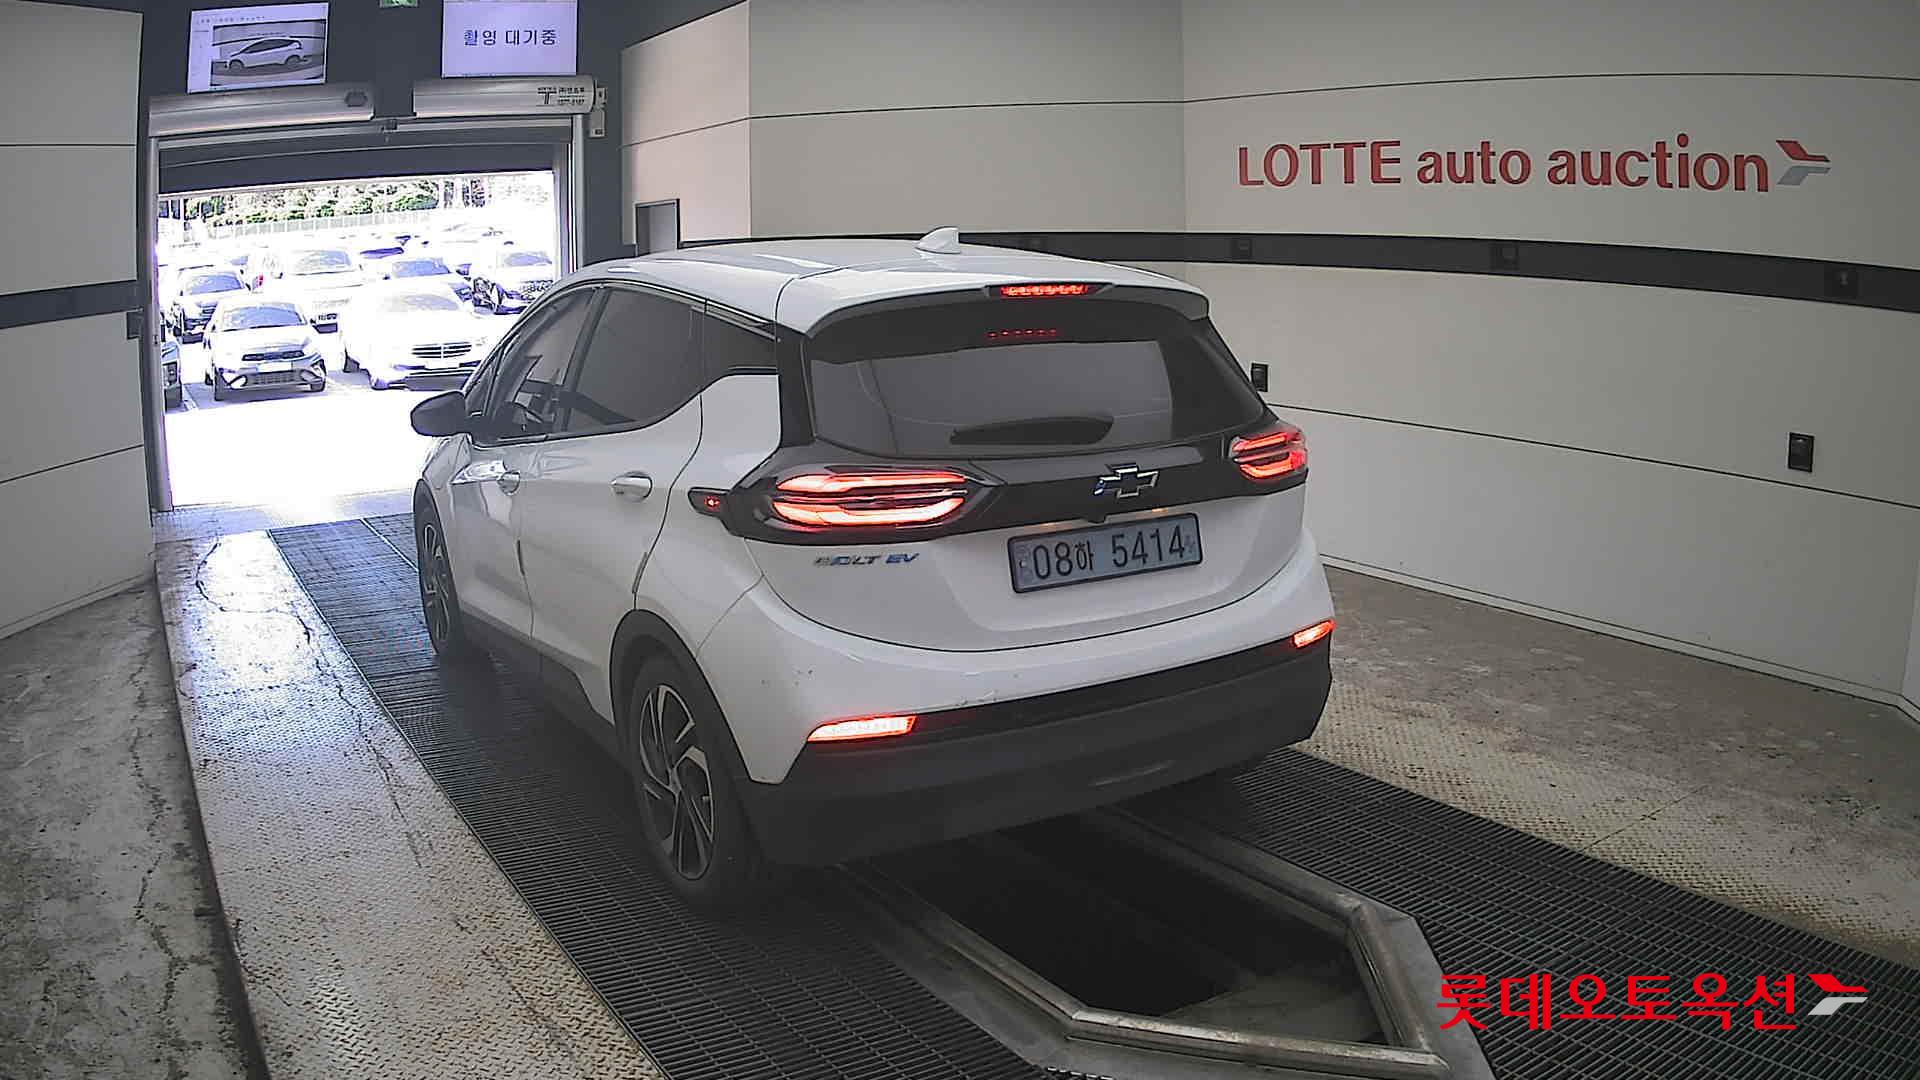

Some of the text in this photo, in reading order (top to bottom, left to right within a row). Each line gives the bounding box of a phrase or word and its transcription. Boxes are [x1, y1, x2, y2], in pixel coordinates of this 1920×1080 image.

[505, 29, 557, 46] 대기중
[1238, 133, 1769, 193] LOTTE auto auction
[886, 552, 920, 565] EV
[1032, 525, 1186, 580] 08하 5414
